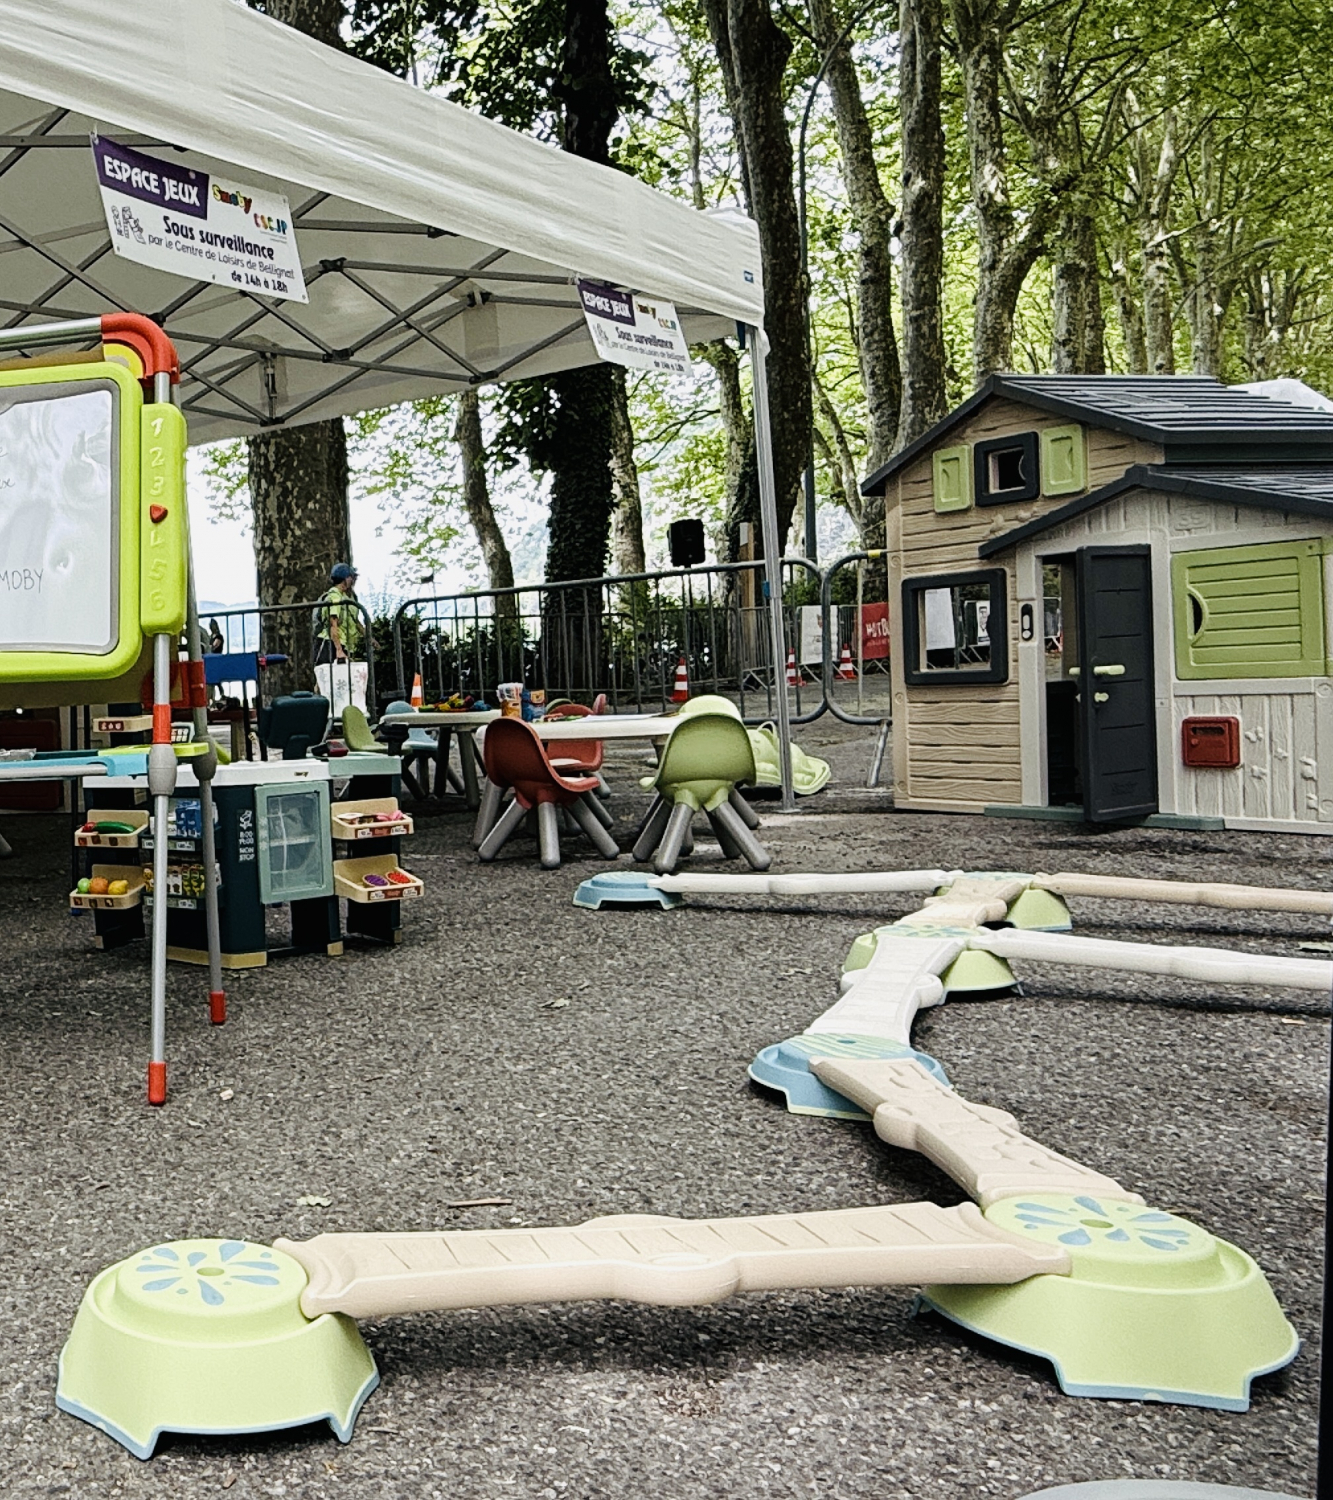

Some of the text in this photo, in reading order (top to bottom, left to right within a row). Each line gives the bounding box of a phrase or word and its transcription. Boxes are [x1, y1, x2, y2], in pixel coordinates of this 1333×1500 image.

[103, 155, 200, 206] ESPACE JEUX
[163, 215, 195, 240] Sous
[199, 229, 274, 260] surveillance
[148, 234, 164, 246] par
[166, 236, 173, 250] le
[175, 240, 203, 258] Centre
[205, 248, 216, 261] de
[218, 252, 245, 268] Loisirs
[247, 259, 257, 271] de
[231, 270, 242, 283] de
[245, 273, 261, 288] 14h
[272, 279, 289, 293] 18h
[151, 417, 164, 437] 1
[150, 447, 165, 467] 2
[150, 476, 164, 496] 3
[239, 853, 255, 861] STOP
